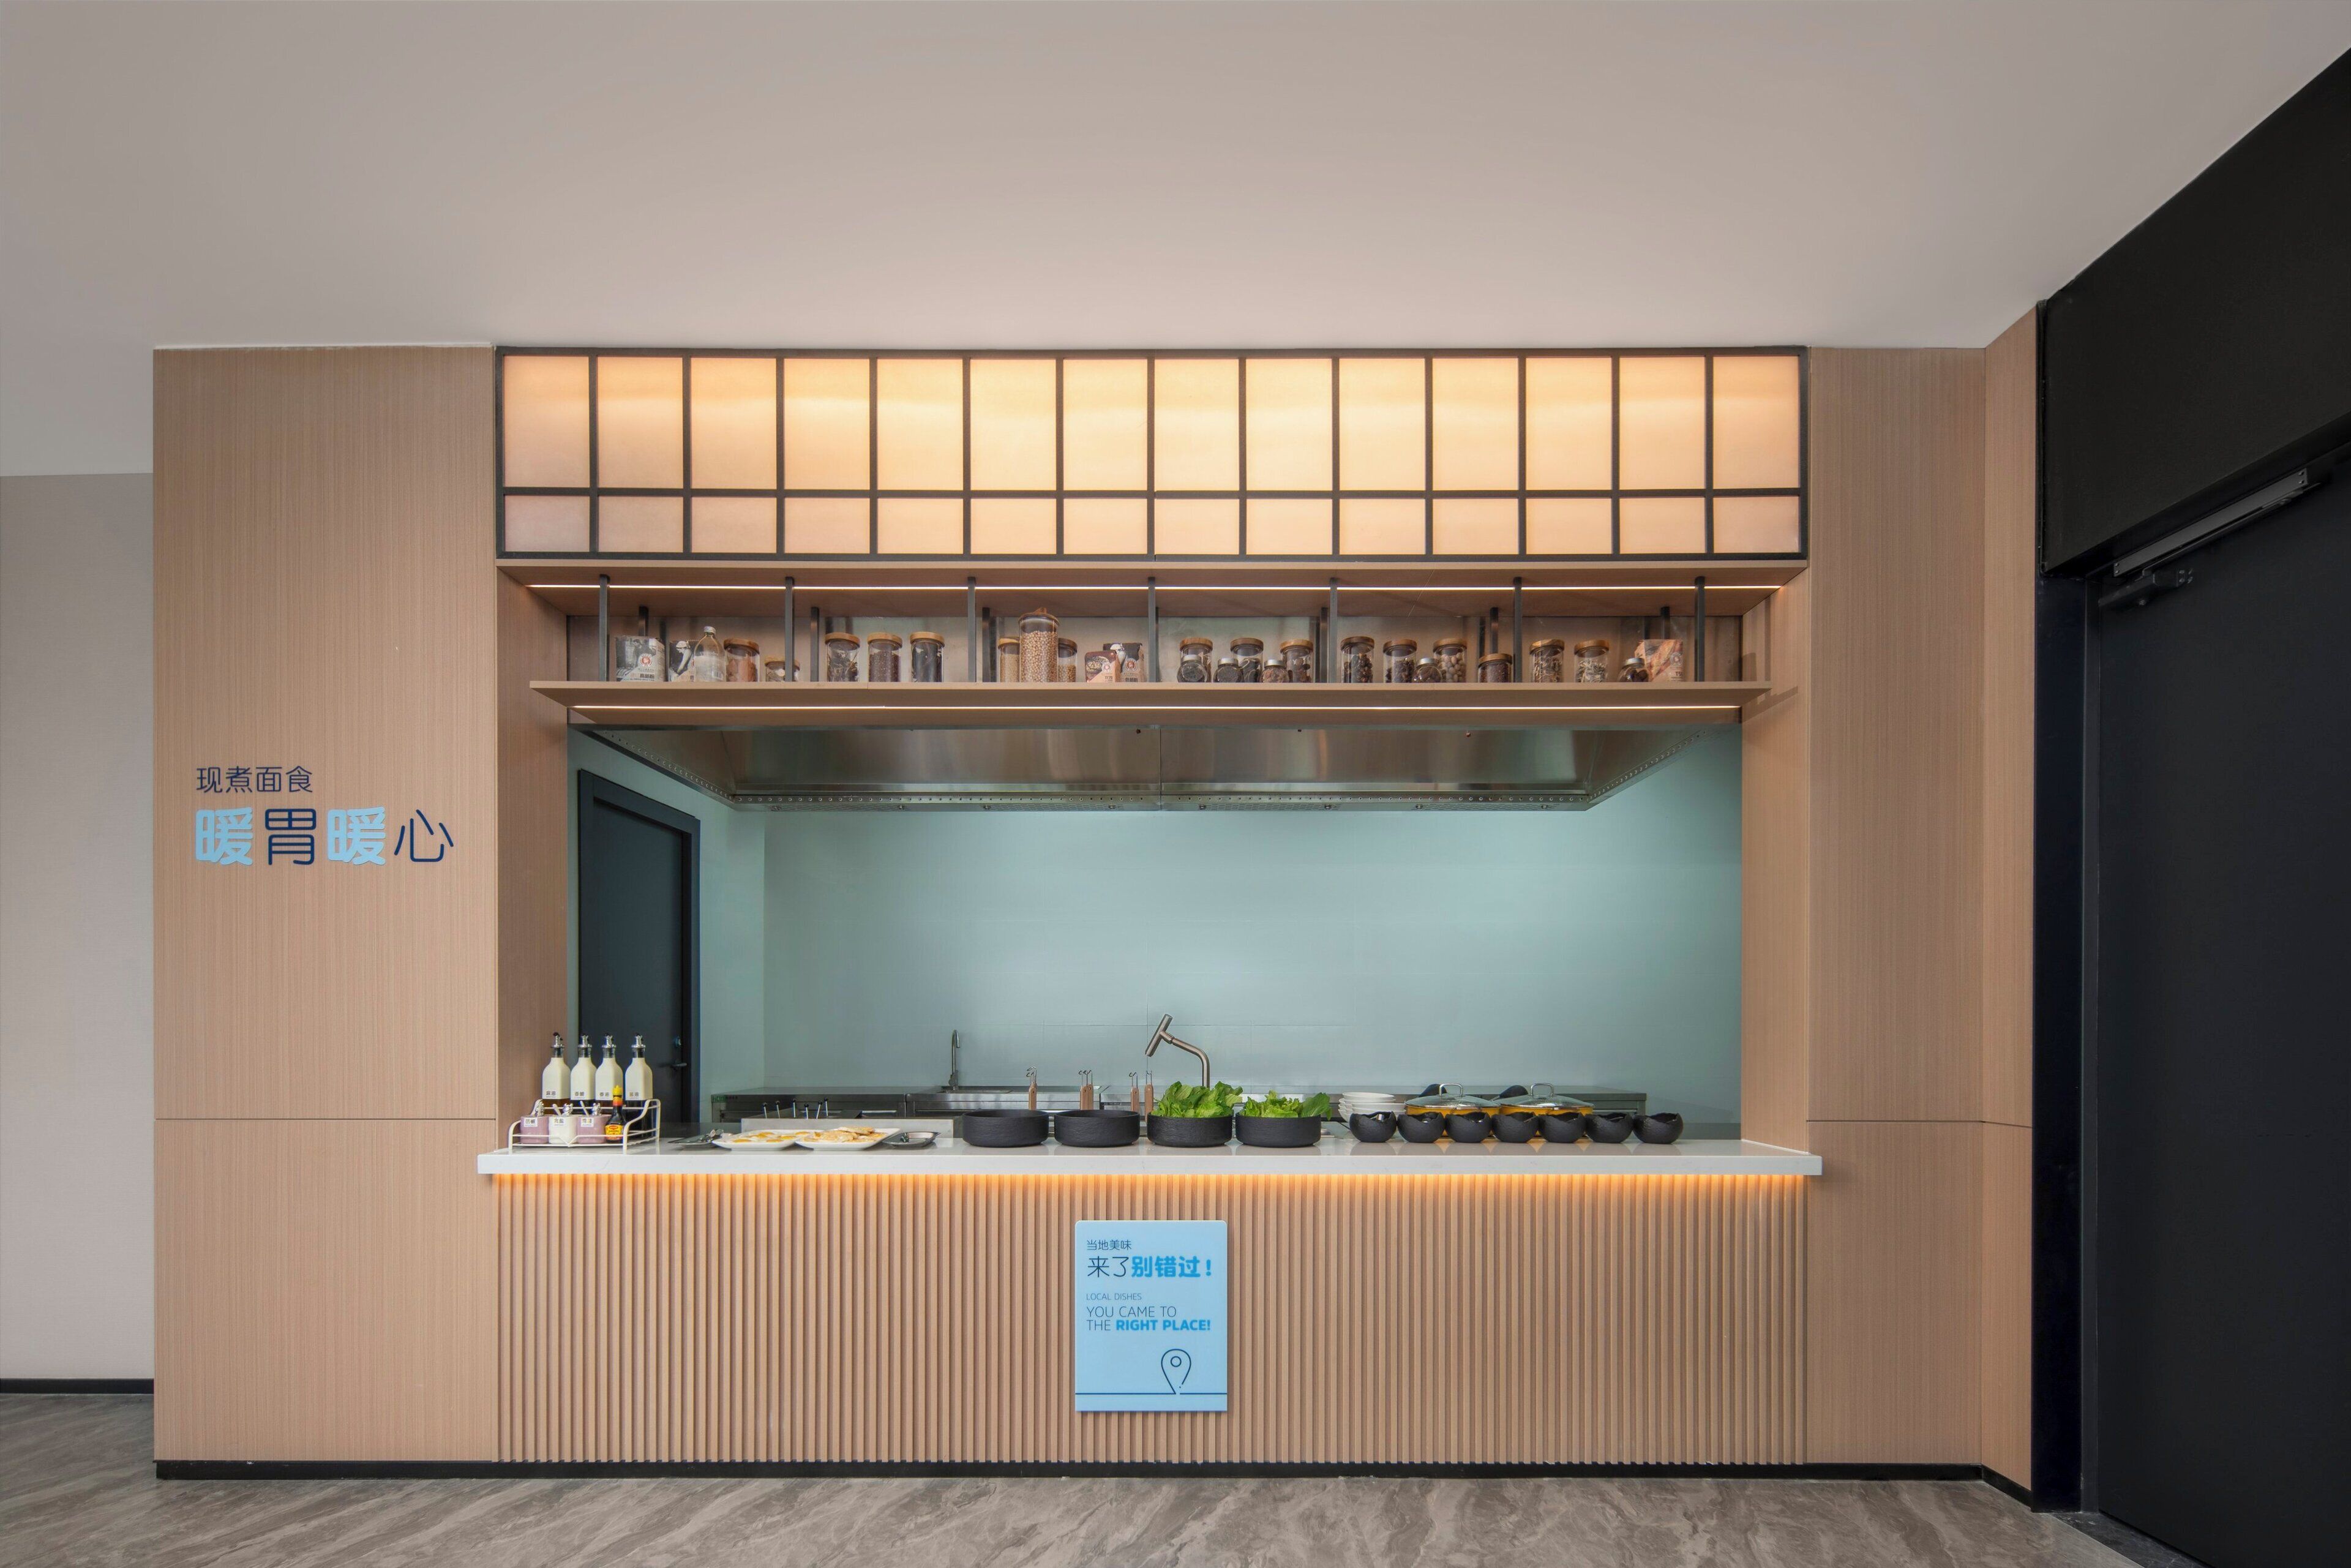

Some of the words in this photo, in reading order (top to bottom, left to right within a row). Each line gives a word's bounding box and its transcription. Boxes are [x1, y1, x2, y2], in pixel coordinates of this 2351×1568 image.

[196, 765, 313, 793] 现煮面食
[195, 806, 455, 866] 暖胃暖心
[1087, 1239, 1131, 1251] 当地美味
[1086, 1307, 1114, 1318] YOU
[1119, 1307, 1155, 1318] CAME
[1160, 1306, 1177, 1318] TO
[1086, 1319, 1111, 1330] THE
[1116, 1319, 1158, 1331] RIGHT
[1163, 1319, 1210, 1331] PLACE!
